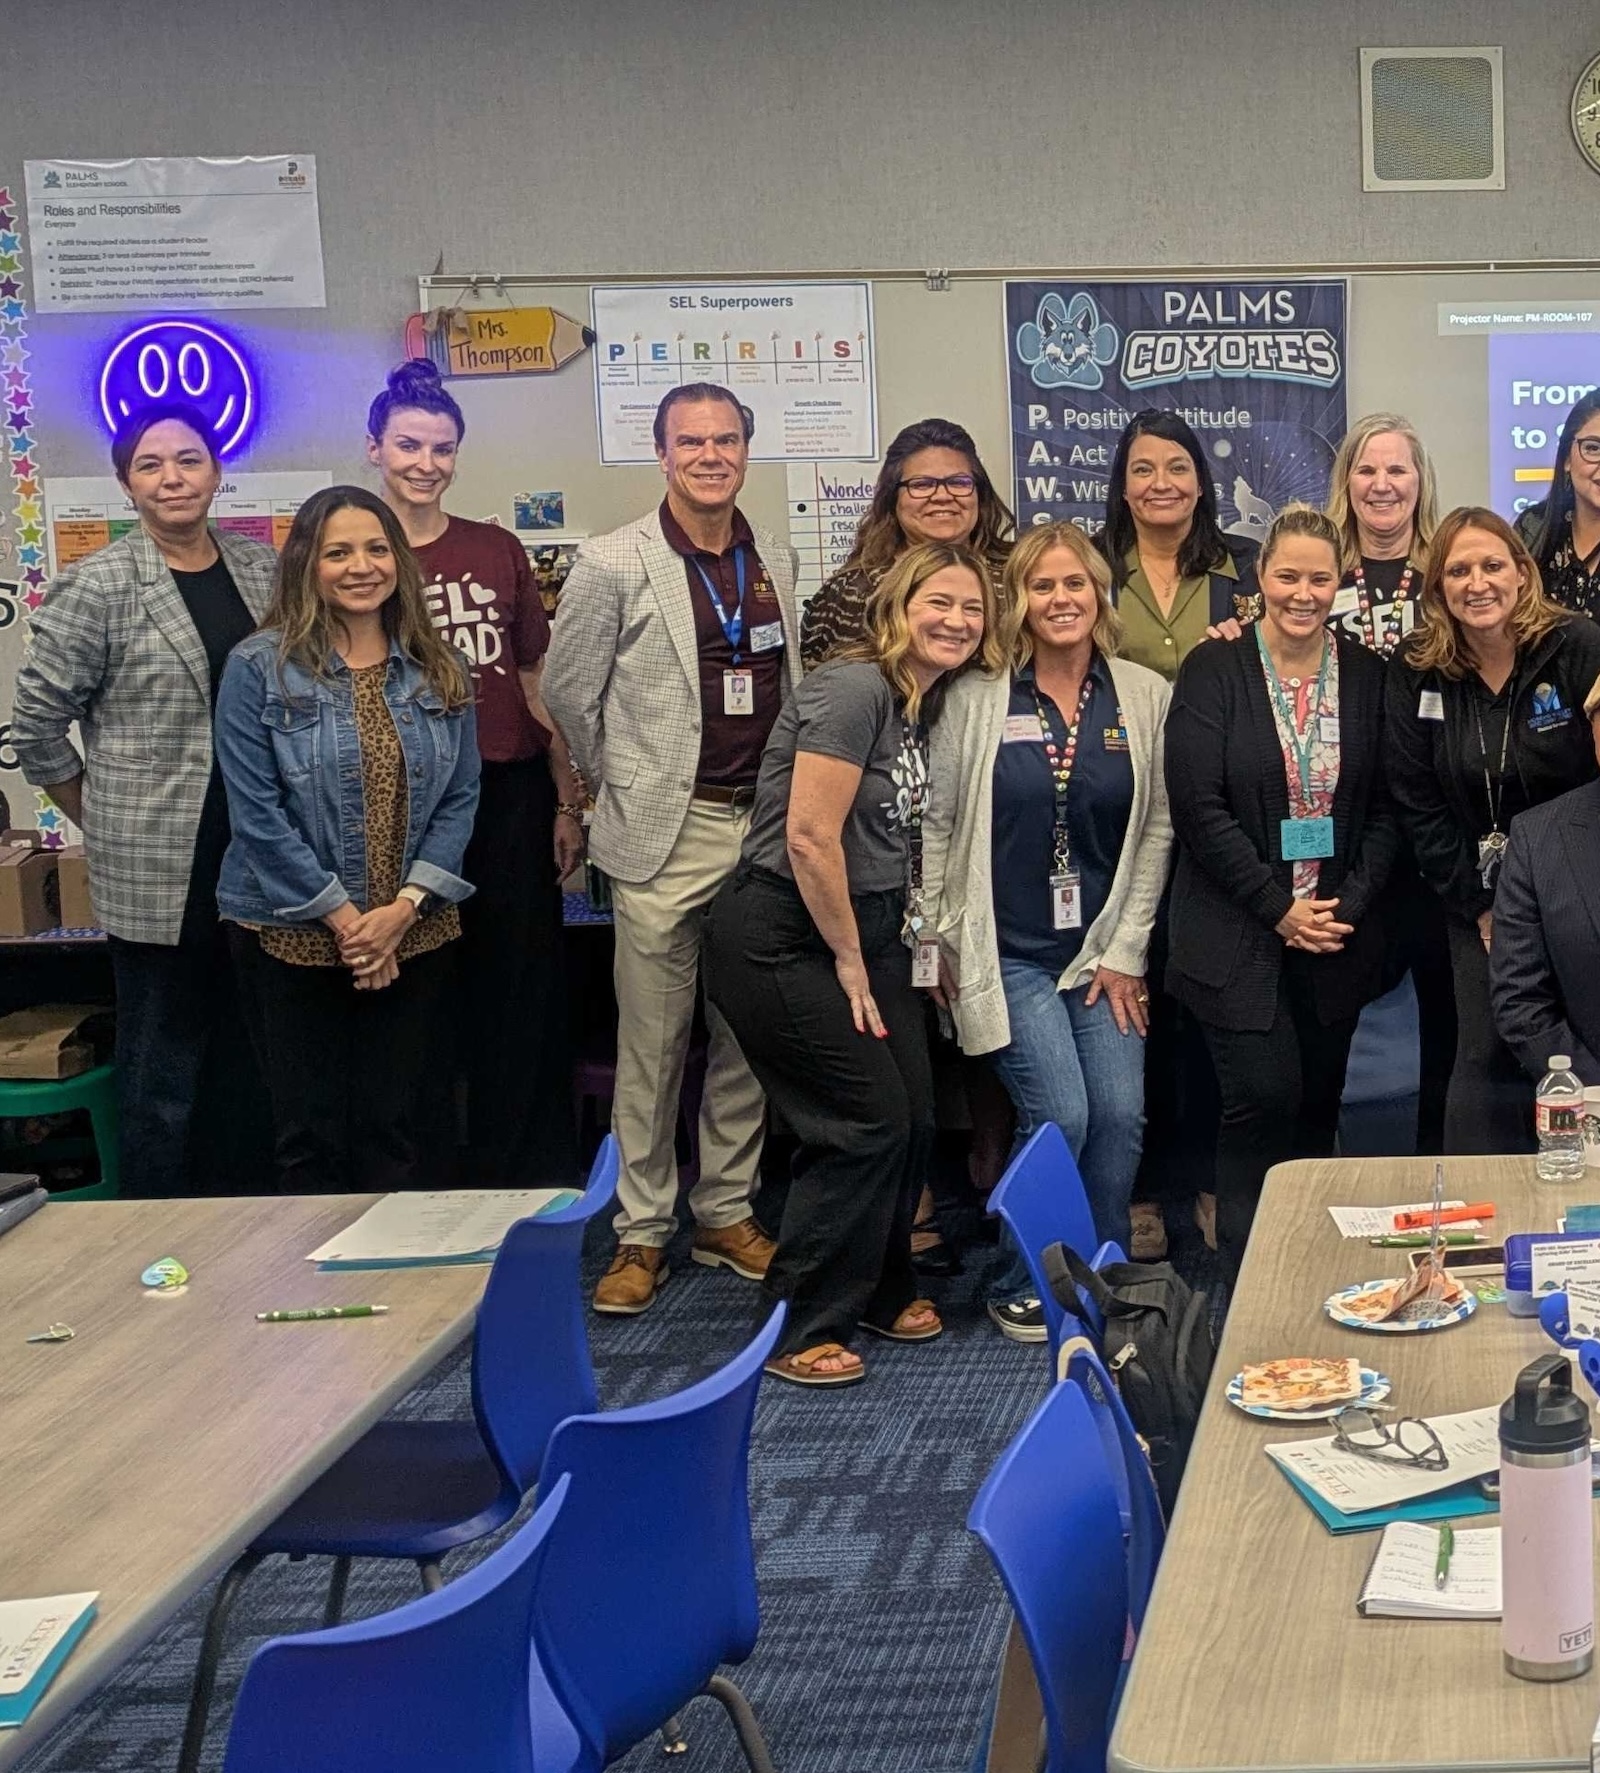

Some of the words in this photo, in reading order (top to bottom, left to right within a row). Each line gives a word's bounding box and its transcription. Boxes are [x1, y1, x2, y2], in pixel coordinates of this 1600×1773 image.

[1587, 107, 1597, 121] 9
[65, 172, 98, 181] PALMS
[44, 204, 74, 216] Roles
[77, 204, 96, 216] and
[99, 202, 181, 218] Responsibilities
[44, 220, 77, 229] Everyone
[669, 295, 696, 309] SEL
[699, 294, 793, 312] Superpowers
[1164, 290, 1296, 324] PALMS
[478, 318, 508, 339] Mrs.
[1450, 313, 1489, 325] Projector
[1493, 313, 1523, 323] Name:
[1526, 312, 1592, 323] PM-ROOM-107
[452, 341, 544, 368] Thompson
[1123, 334, 1339, 382] COYOTES
[1028, 404, 1052, 428] P.
[1064, 408, 1137, 428] Positiv
[1177, 407, 1251, 428] ttitude
[1512, 425, 1547, 448] to
[1028, 440, 1060, 465] A.
[1069, 444, 1108, 464] Act
[1025, 477, 1063, 501] W.
[1072, 480, 1109, 500] Wis
[831, 520, 864, 531] resou
[1071, 516, 1106, 535] Sta
[1563, 1628, 1591, 1649] YETI
